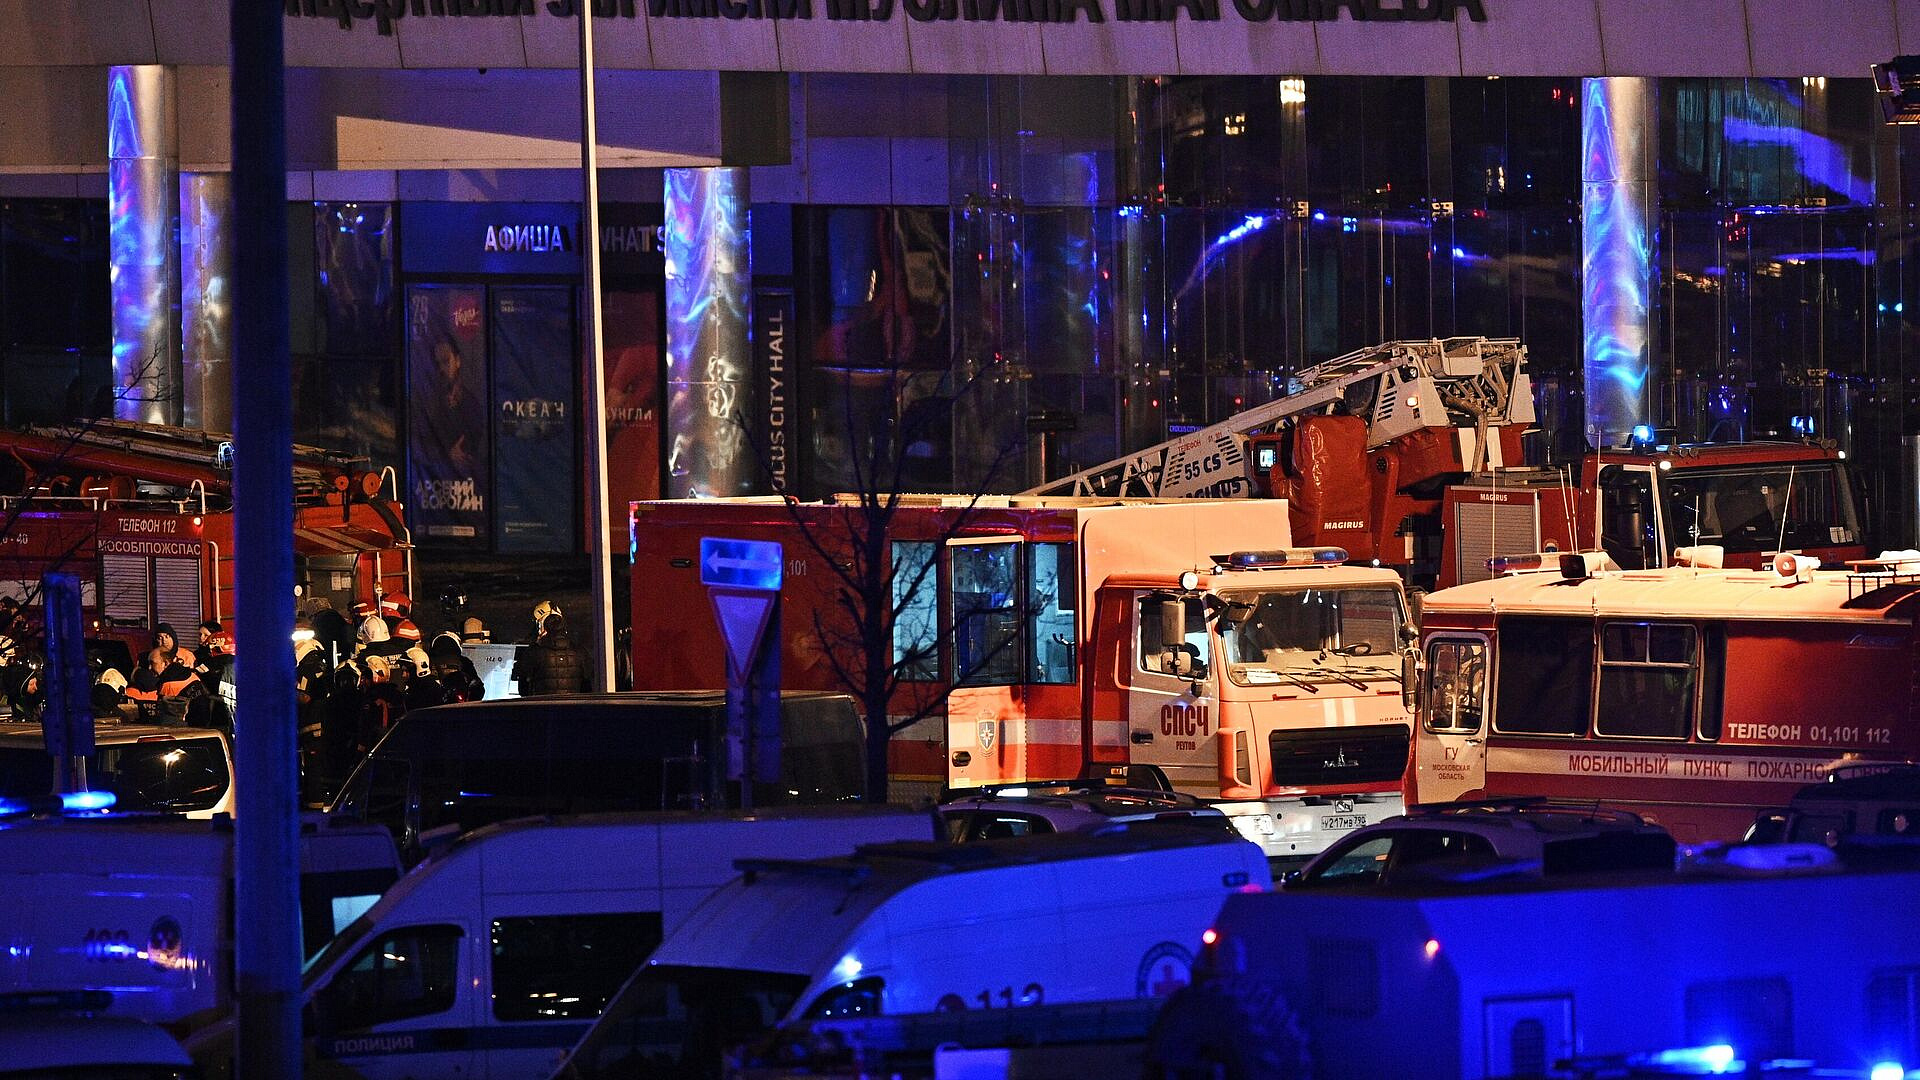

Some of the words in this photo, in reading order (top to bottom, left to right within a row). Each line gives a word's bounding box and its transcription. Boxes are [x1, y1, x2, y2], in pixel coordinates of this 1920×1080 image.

[485, 225, 564, 252] АФИША
[769, 309, 784, 372] HALL
[769, 376, 784, 427] CITY
[769, 430, 786, 494] OCUS
[1184, 460, 1200, 480] 55
[1203, 453, 1221, 473] CS
[1480, 493, 1508, 502] MAGIRUS
[118, 518, 160, 533] ТЕЛЕФОН
[162, 519, 176, 534] 112
[1324, 520, 1364, 530] MAGIRUS
[98, 539, 201, 556] МОСОБЛПОЖСПАС
[786, 559, 807, 578] ,101
[1161, 704, 1209, 737] СПСЧ
[1728, 723, 1801, 741] ТЕЛЕФОН
[1810, 726, 1859, 744] 01,101
[1866, 728, 1890, 743] 112
[1175, 741, 1196, 750] РЕУТОВ
[1444, 747, 1459, 761] ГУ
[1432, 764, 1471, 772] МОСКОВСКАЯ
[1569, 753, 1668, 775] МОБИЛЬНЫЙ
[1684, 756, 1732, 778] ПУНКТ
[1748, 761, 1831, 781] ПОЖАРНО
[1438, 773, 1465, 781] ОБЛАСТЬ
[335, 1035, 415, 1054] ПОЛИЦИЯ
